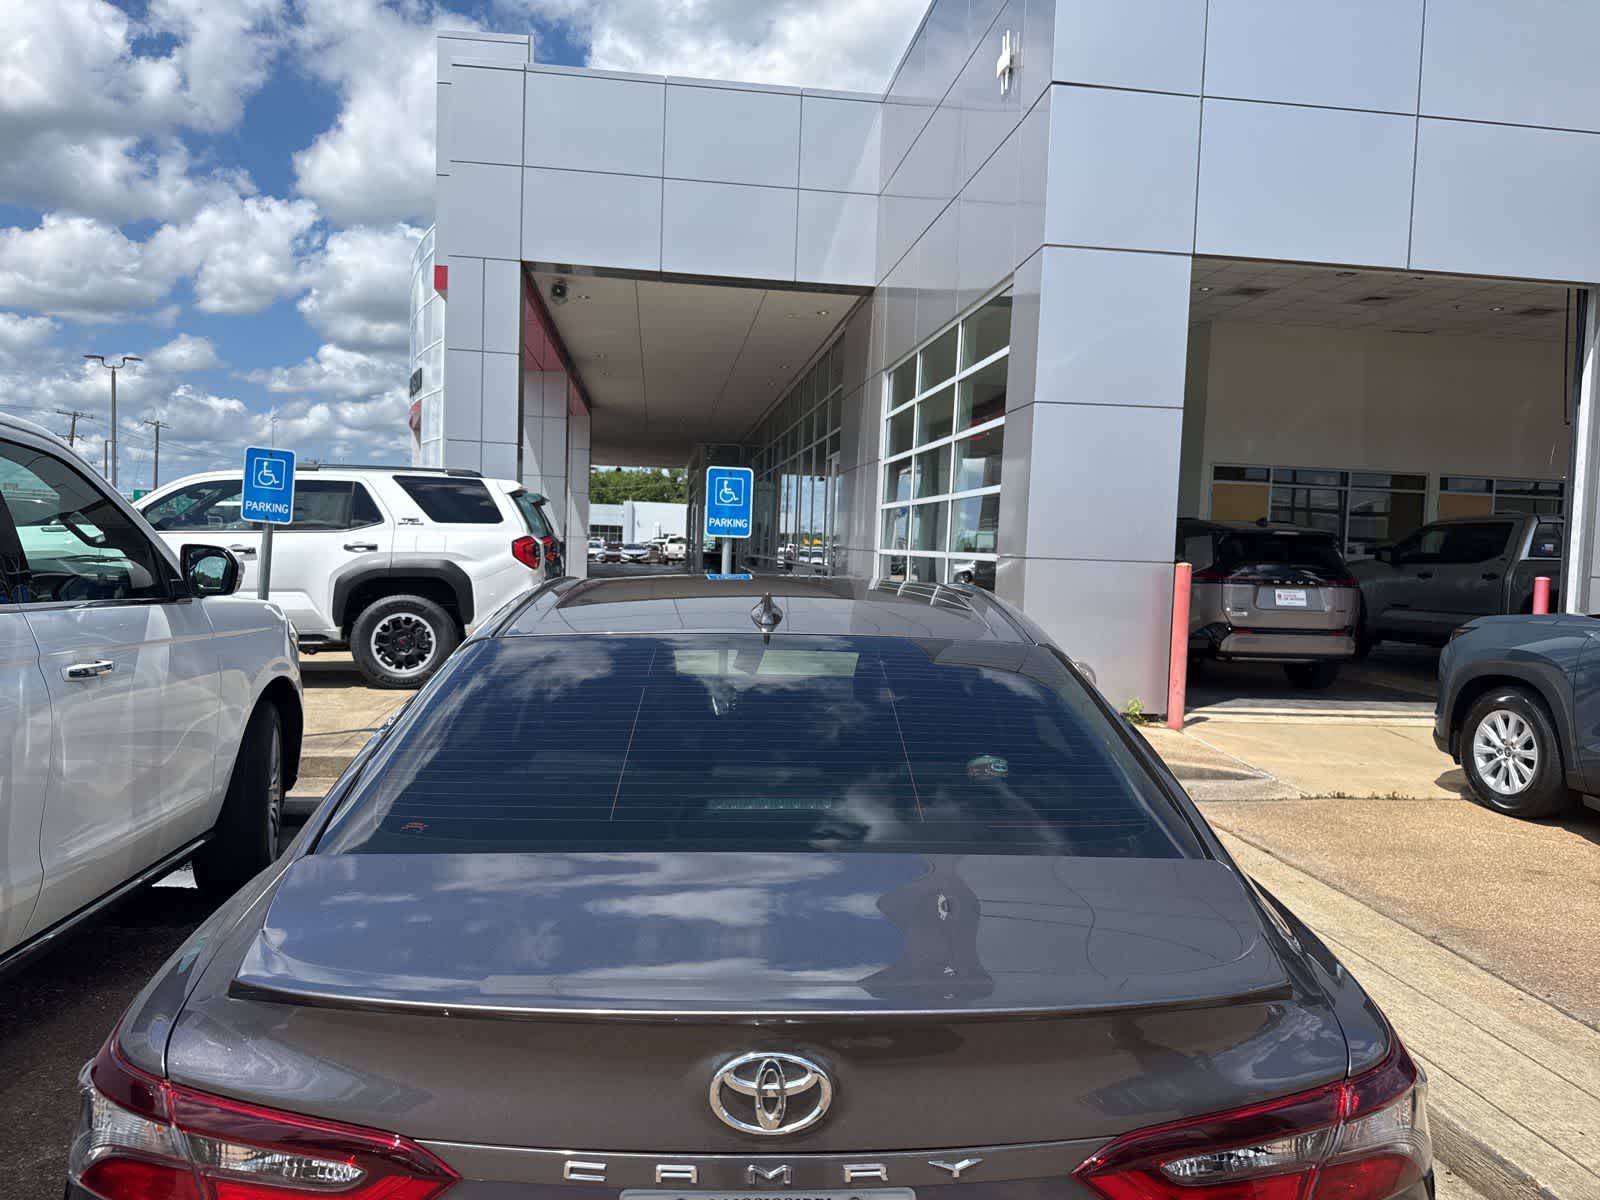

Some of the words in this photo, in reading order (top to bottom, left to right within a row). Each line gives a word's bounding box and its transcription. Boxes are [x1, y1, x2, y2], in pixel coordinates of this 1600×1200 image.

[245, 500, 289, 514] PARKING
[708, 517, 748, 528] PARKING
[563, 1158, 984, 1185] CAMRY
